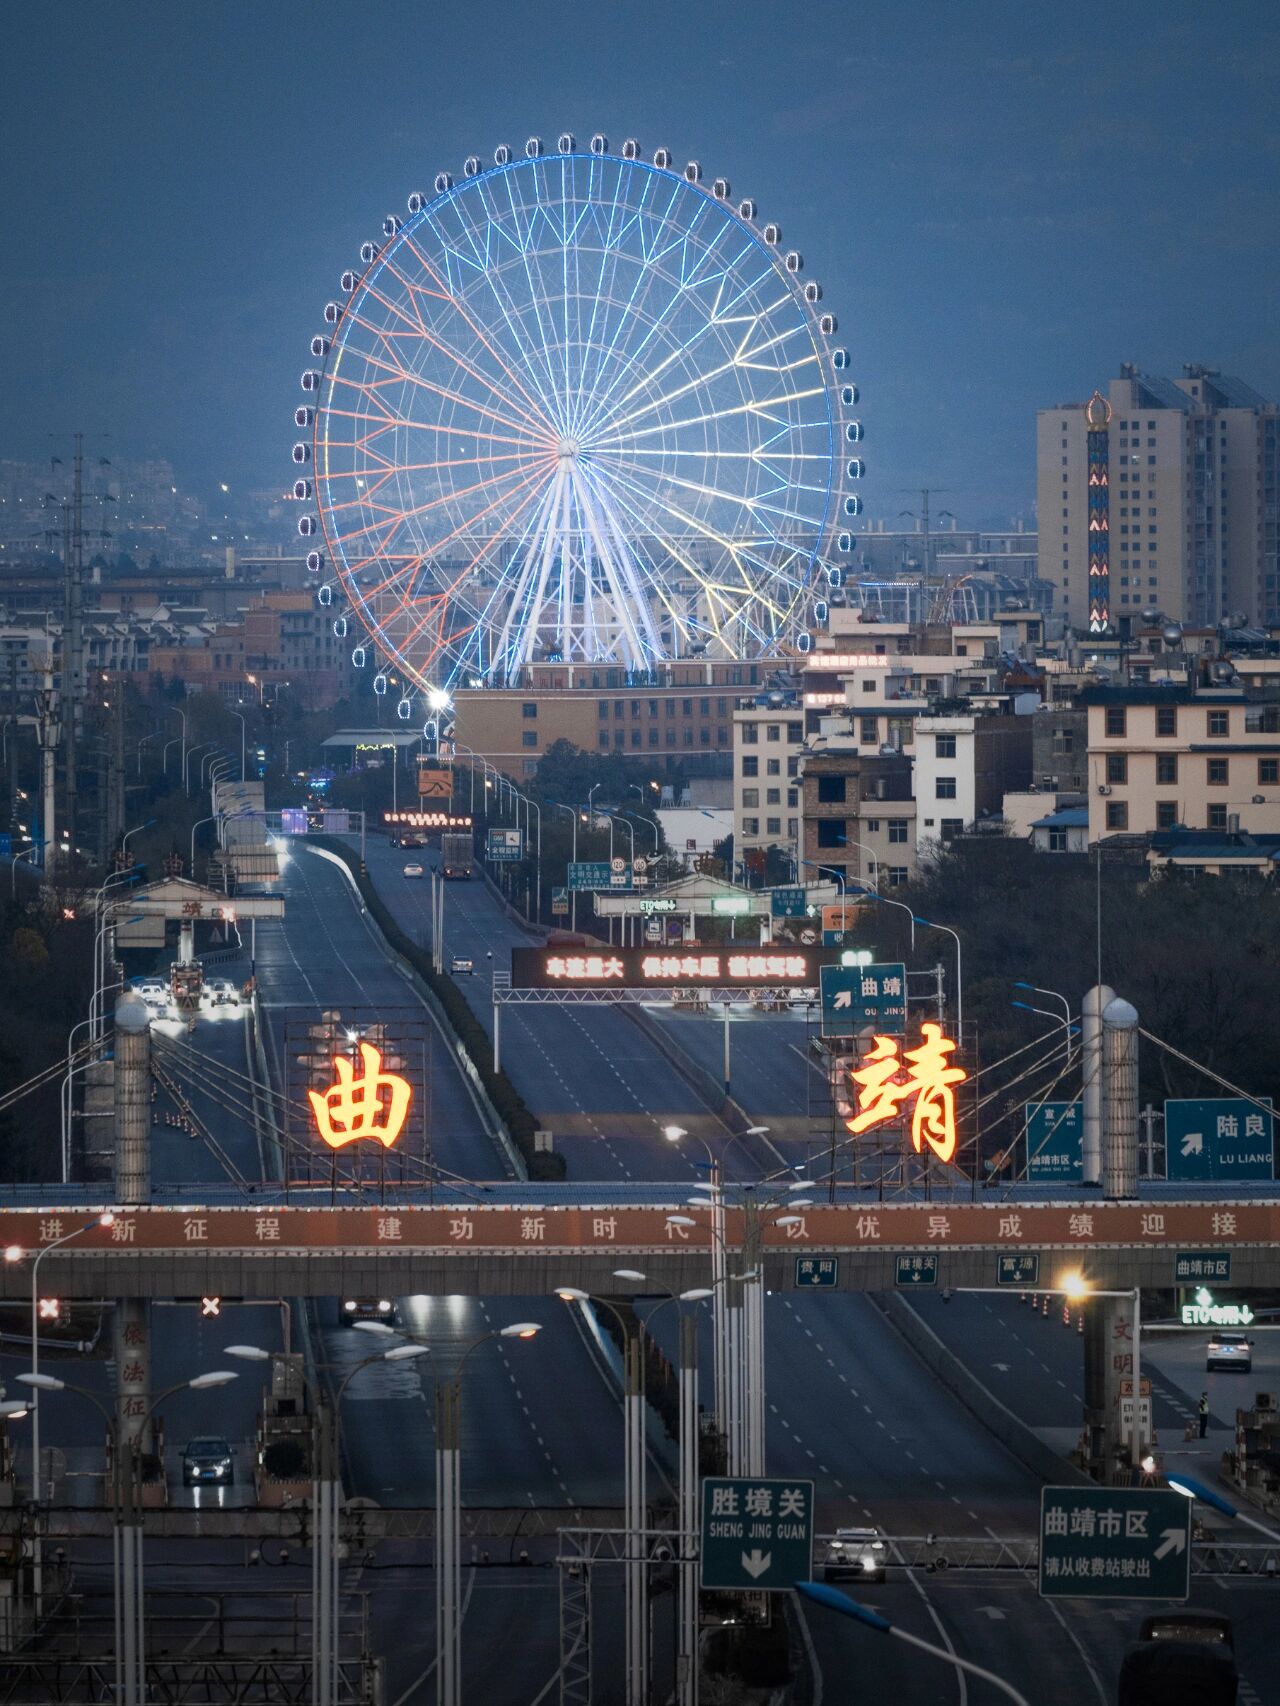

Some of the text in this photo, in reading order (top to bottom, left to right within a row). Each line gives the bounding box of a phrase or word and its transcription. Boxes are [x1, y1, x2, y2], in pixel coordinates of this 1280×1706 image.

[613, 860, 624, 869] 120
[861, 977, 901, 997] 曲靖
[864, 1008, 877, 1016] QU
[308, 1022, 967, 1163] 曲 靖
[1216, 1114, 1266, 1138] 陆良
[1219, 1153, 1273, 1165] LU LIANG
[800, 1260, 833, 1273] 贵阳
[900, 1257, 936, 1271] 胜境关
[1002, 1257, 1034, 1271] 富源
[1177, 1259, 1228, 1276] 曲靖市区
[711, 1486, 805, 1518] 胜境关
[1045, 1506, 1149, 1538] 曲靖市区
[709, 1522, 806, 1540] SHENG JING GUAN
[1045, 1556, 1151, 1578] 请从收费站驶出
